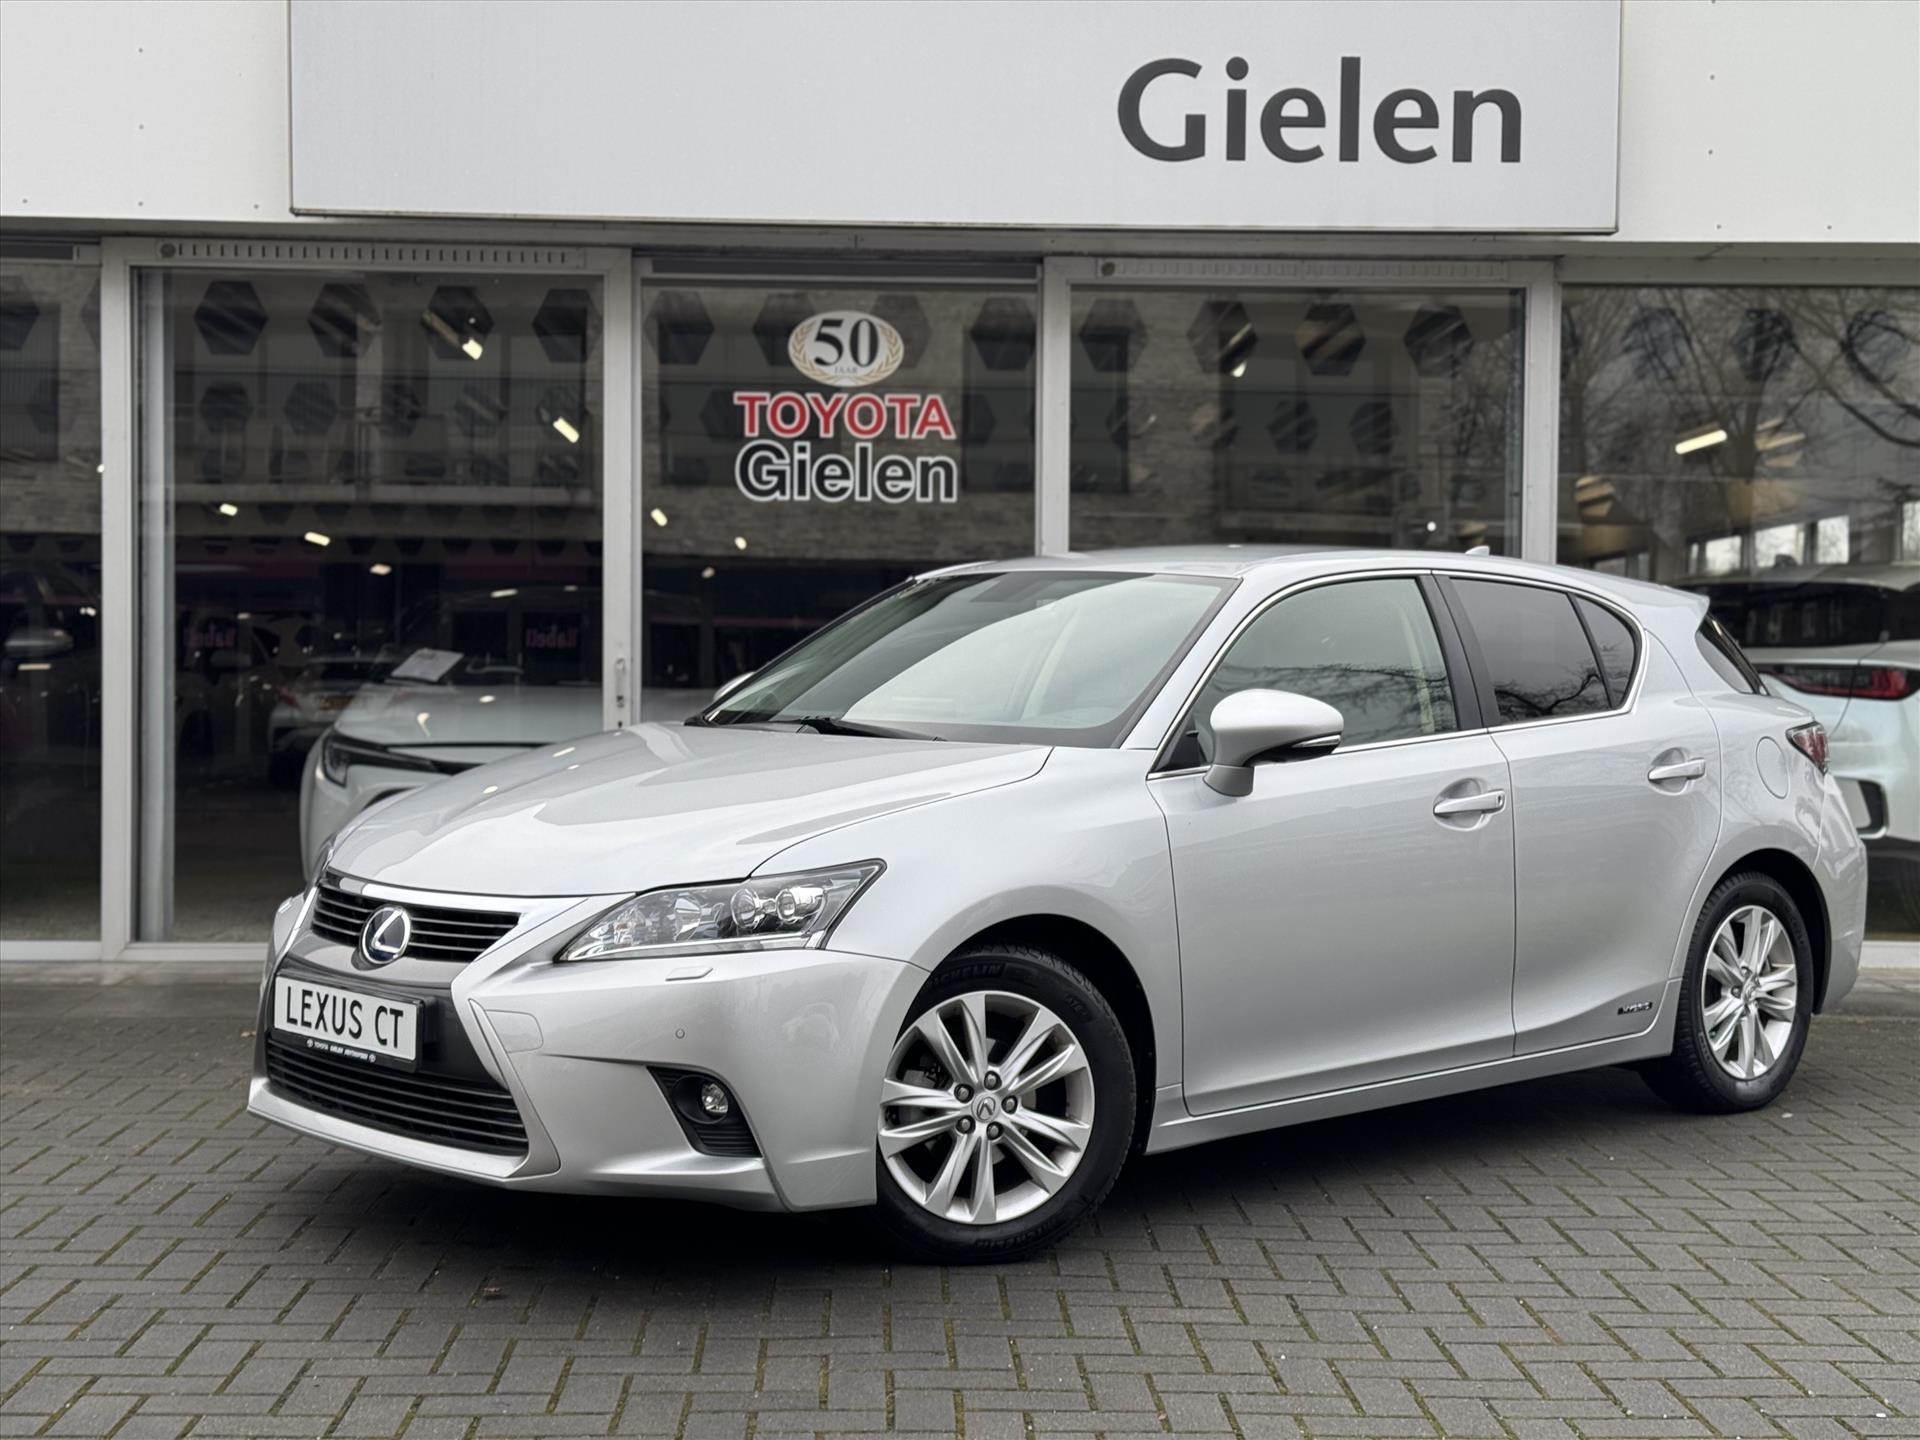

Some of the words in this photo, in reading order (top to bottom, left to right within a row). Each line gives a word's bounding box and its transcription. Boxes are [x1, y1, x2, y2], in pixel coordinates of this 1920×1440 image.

[1117, 56, 1522, 164] Gielen
[813, 318, 880, 367] 50
[733, 391, 957, 439] TOYOTA
[735, 439, 958, 503] Gielen
[286, 985, 363, 1040] LEXUS
[374, 1005, 404, 1049] CT
